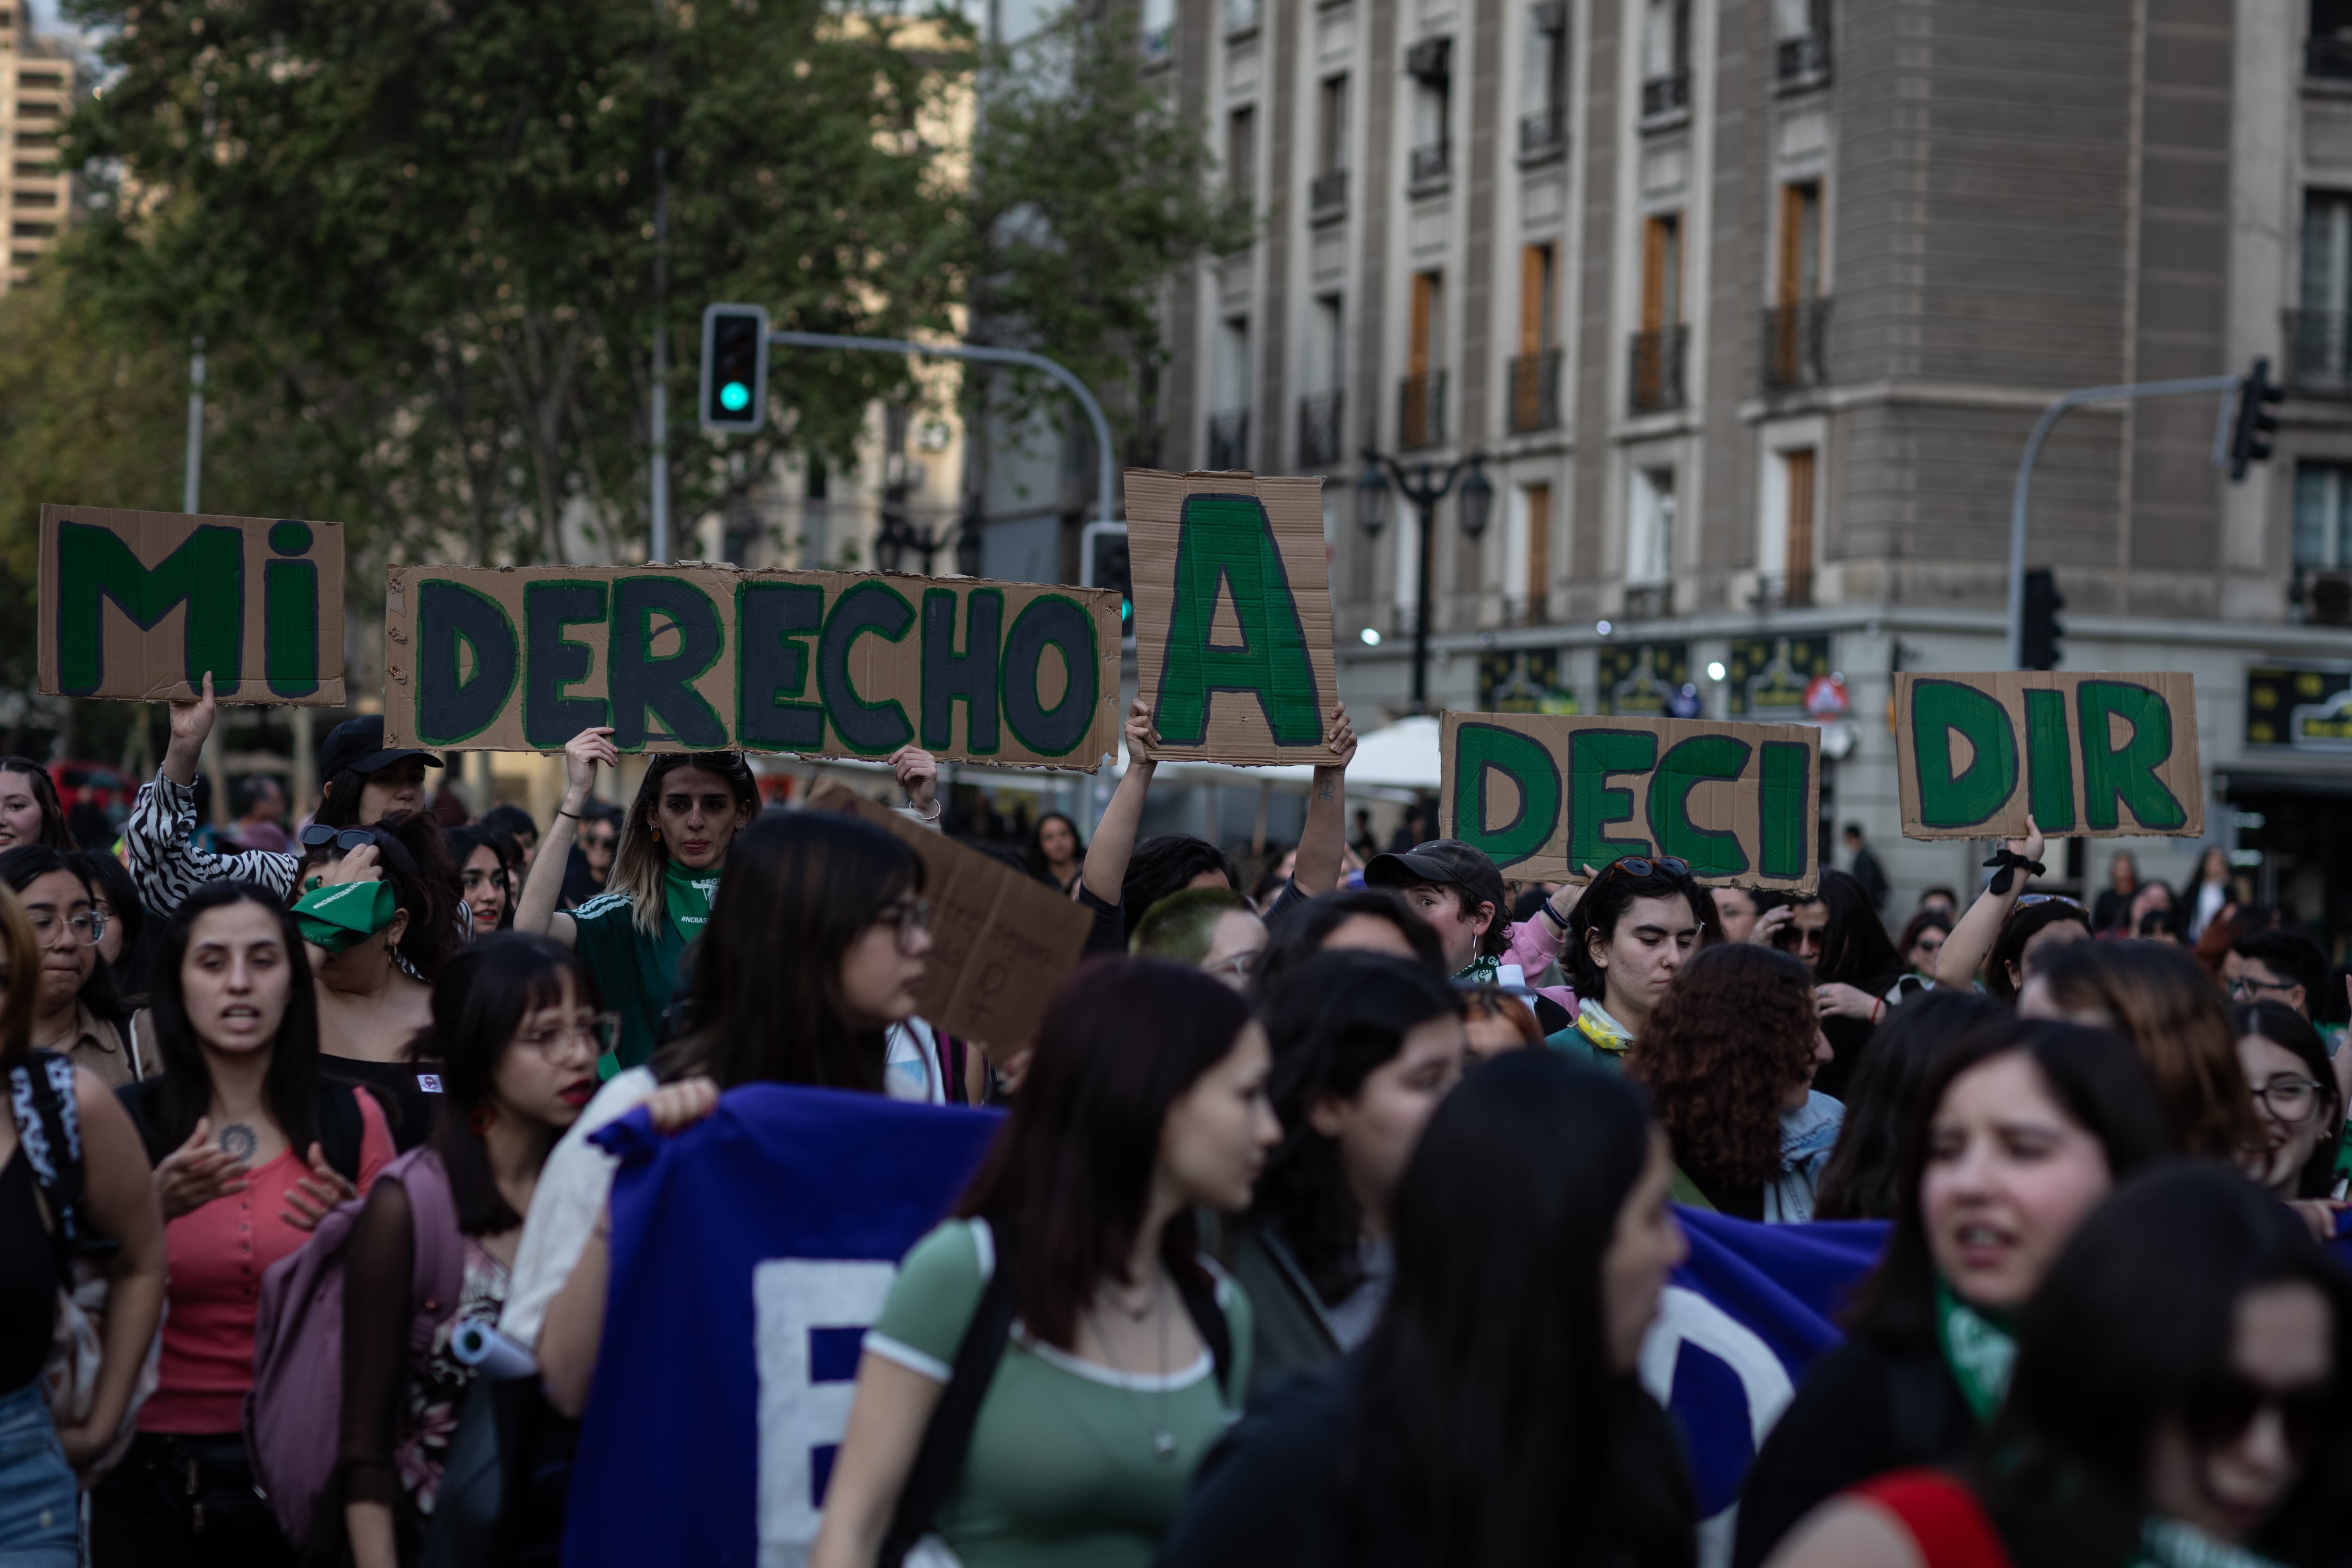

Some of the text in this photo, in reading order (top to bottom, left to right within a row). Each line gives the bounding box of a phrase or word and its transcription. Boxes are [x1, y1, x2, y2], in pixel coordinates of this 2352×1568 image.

[57, 520, 319, 698] Mi
[416, 575, 1099, 757] DERECHO
[1152, 492, 1324, 747] A
[1452, 722, 1810, 880] DECI
[1911, 679, 2187, 831] DIR
